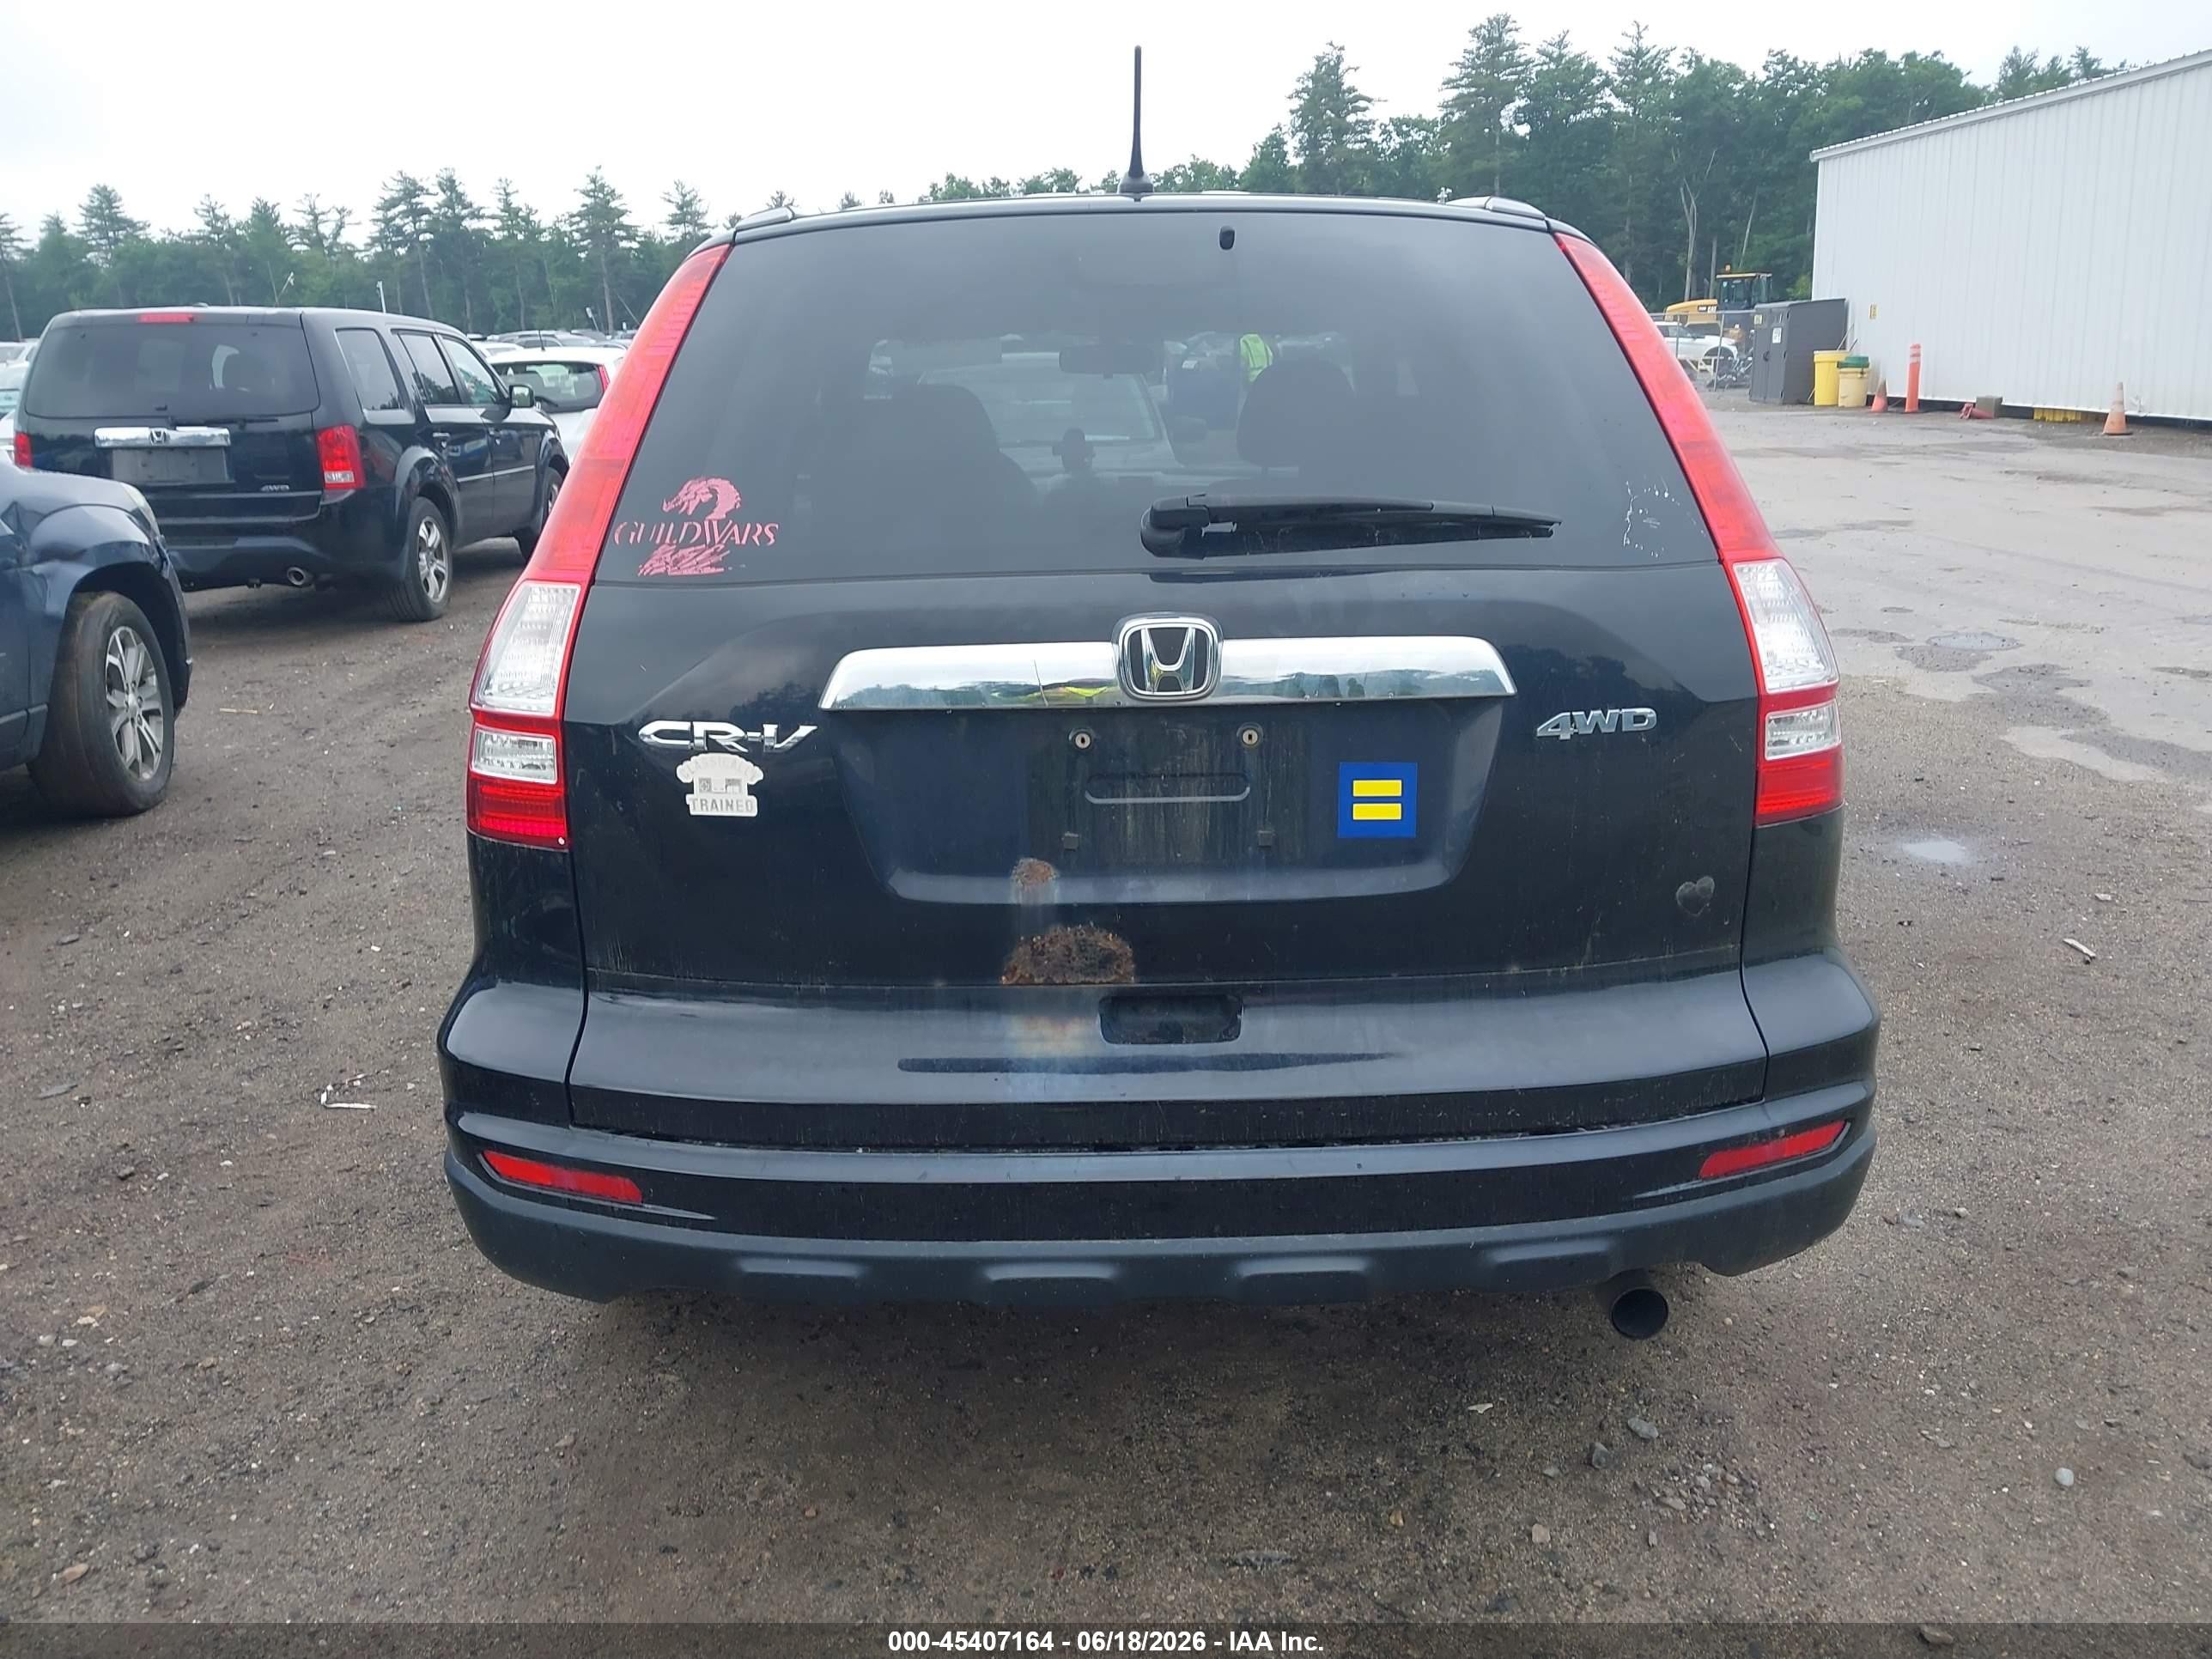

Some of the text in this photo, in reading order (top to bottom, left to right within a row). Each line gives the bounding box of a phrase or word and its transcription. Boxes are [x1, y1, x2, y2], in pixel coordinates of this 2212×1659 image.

[638, 720, 818, 753] CR-V
[1536, 708, 1657, 740] 4WD
[689, 797, 754, 812] TRAINED
